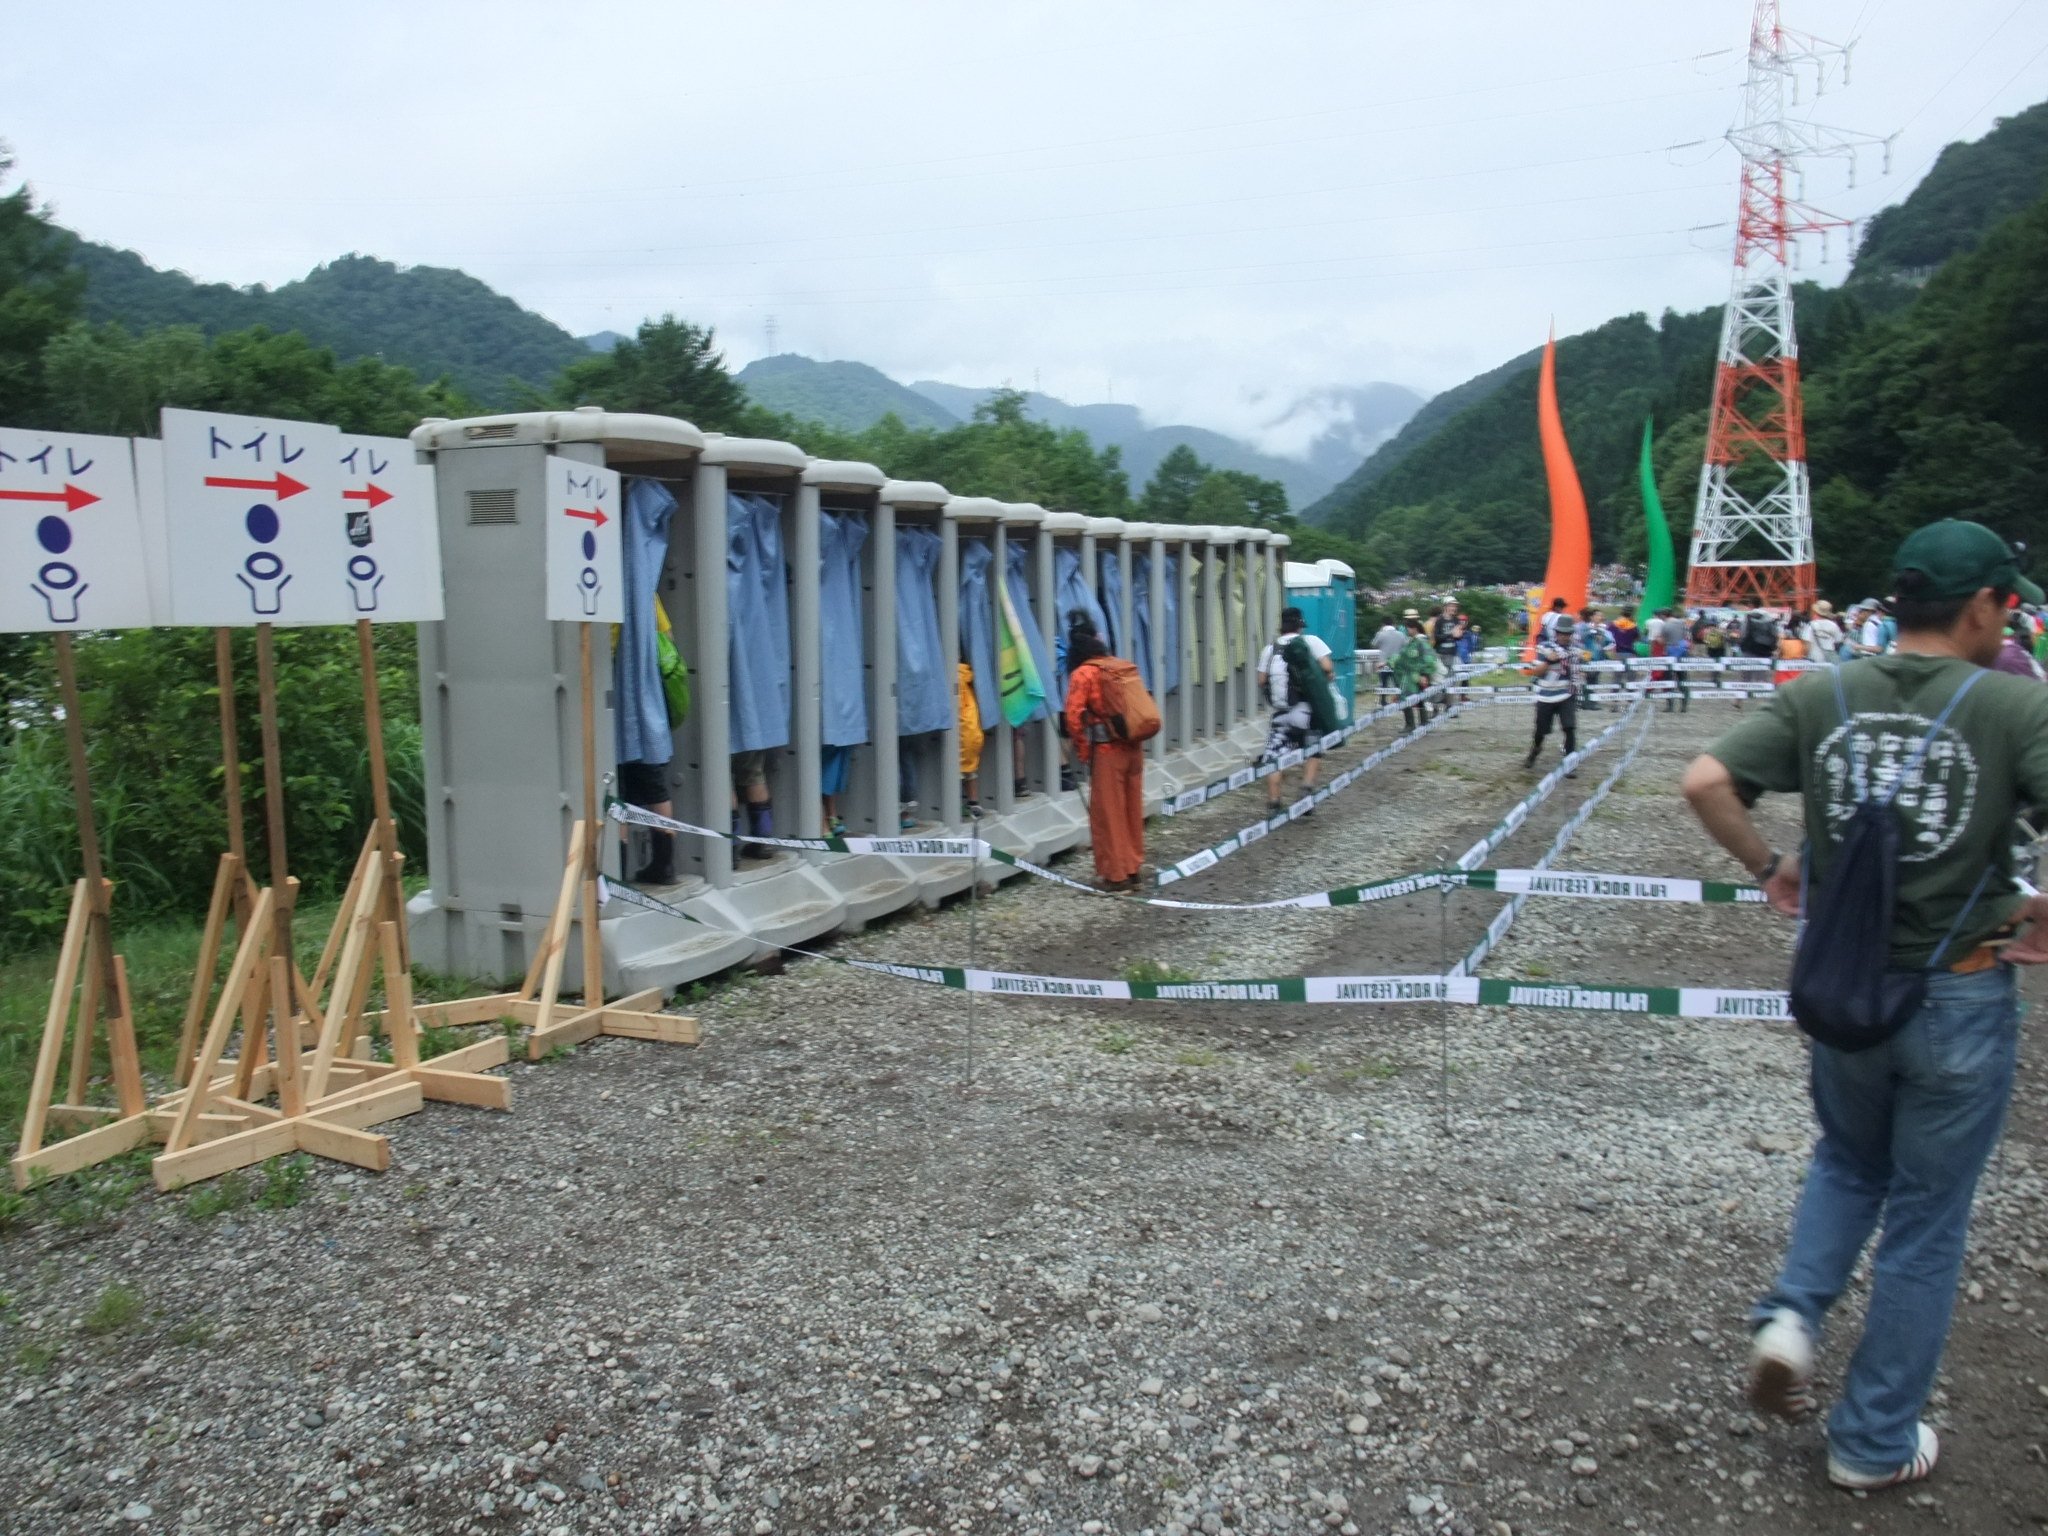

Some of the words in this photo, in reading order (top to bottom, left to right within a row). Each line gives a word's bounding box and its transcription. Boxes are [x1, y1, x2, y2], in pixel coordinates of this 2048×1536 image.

[211, 426, 304, 463] トイレ
[340, 447, 388, 475] イレ
[567, 470, 608, 499] トイレ
